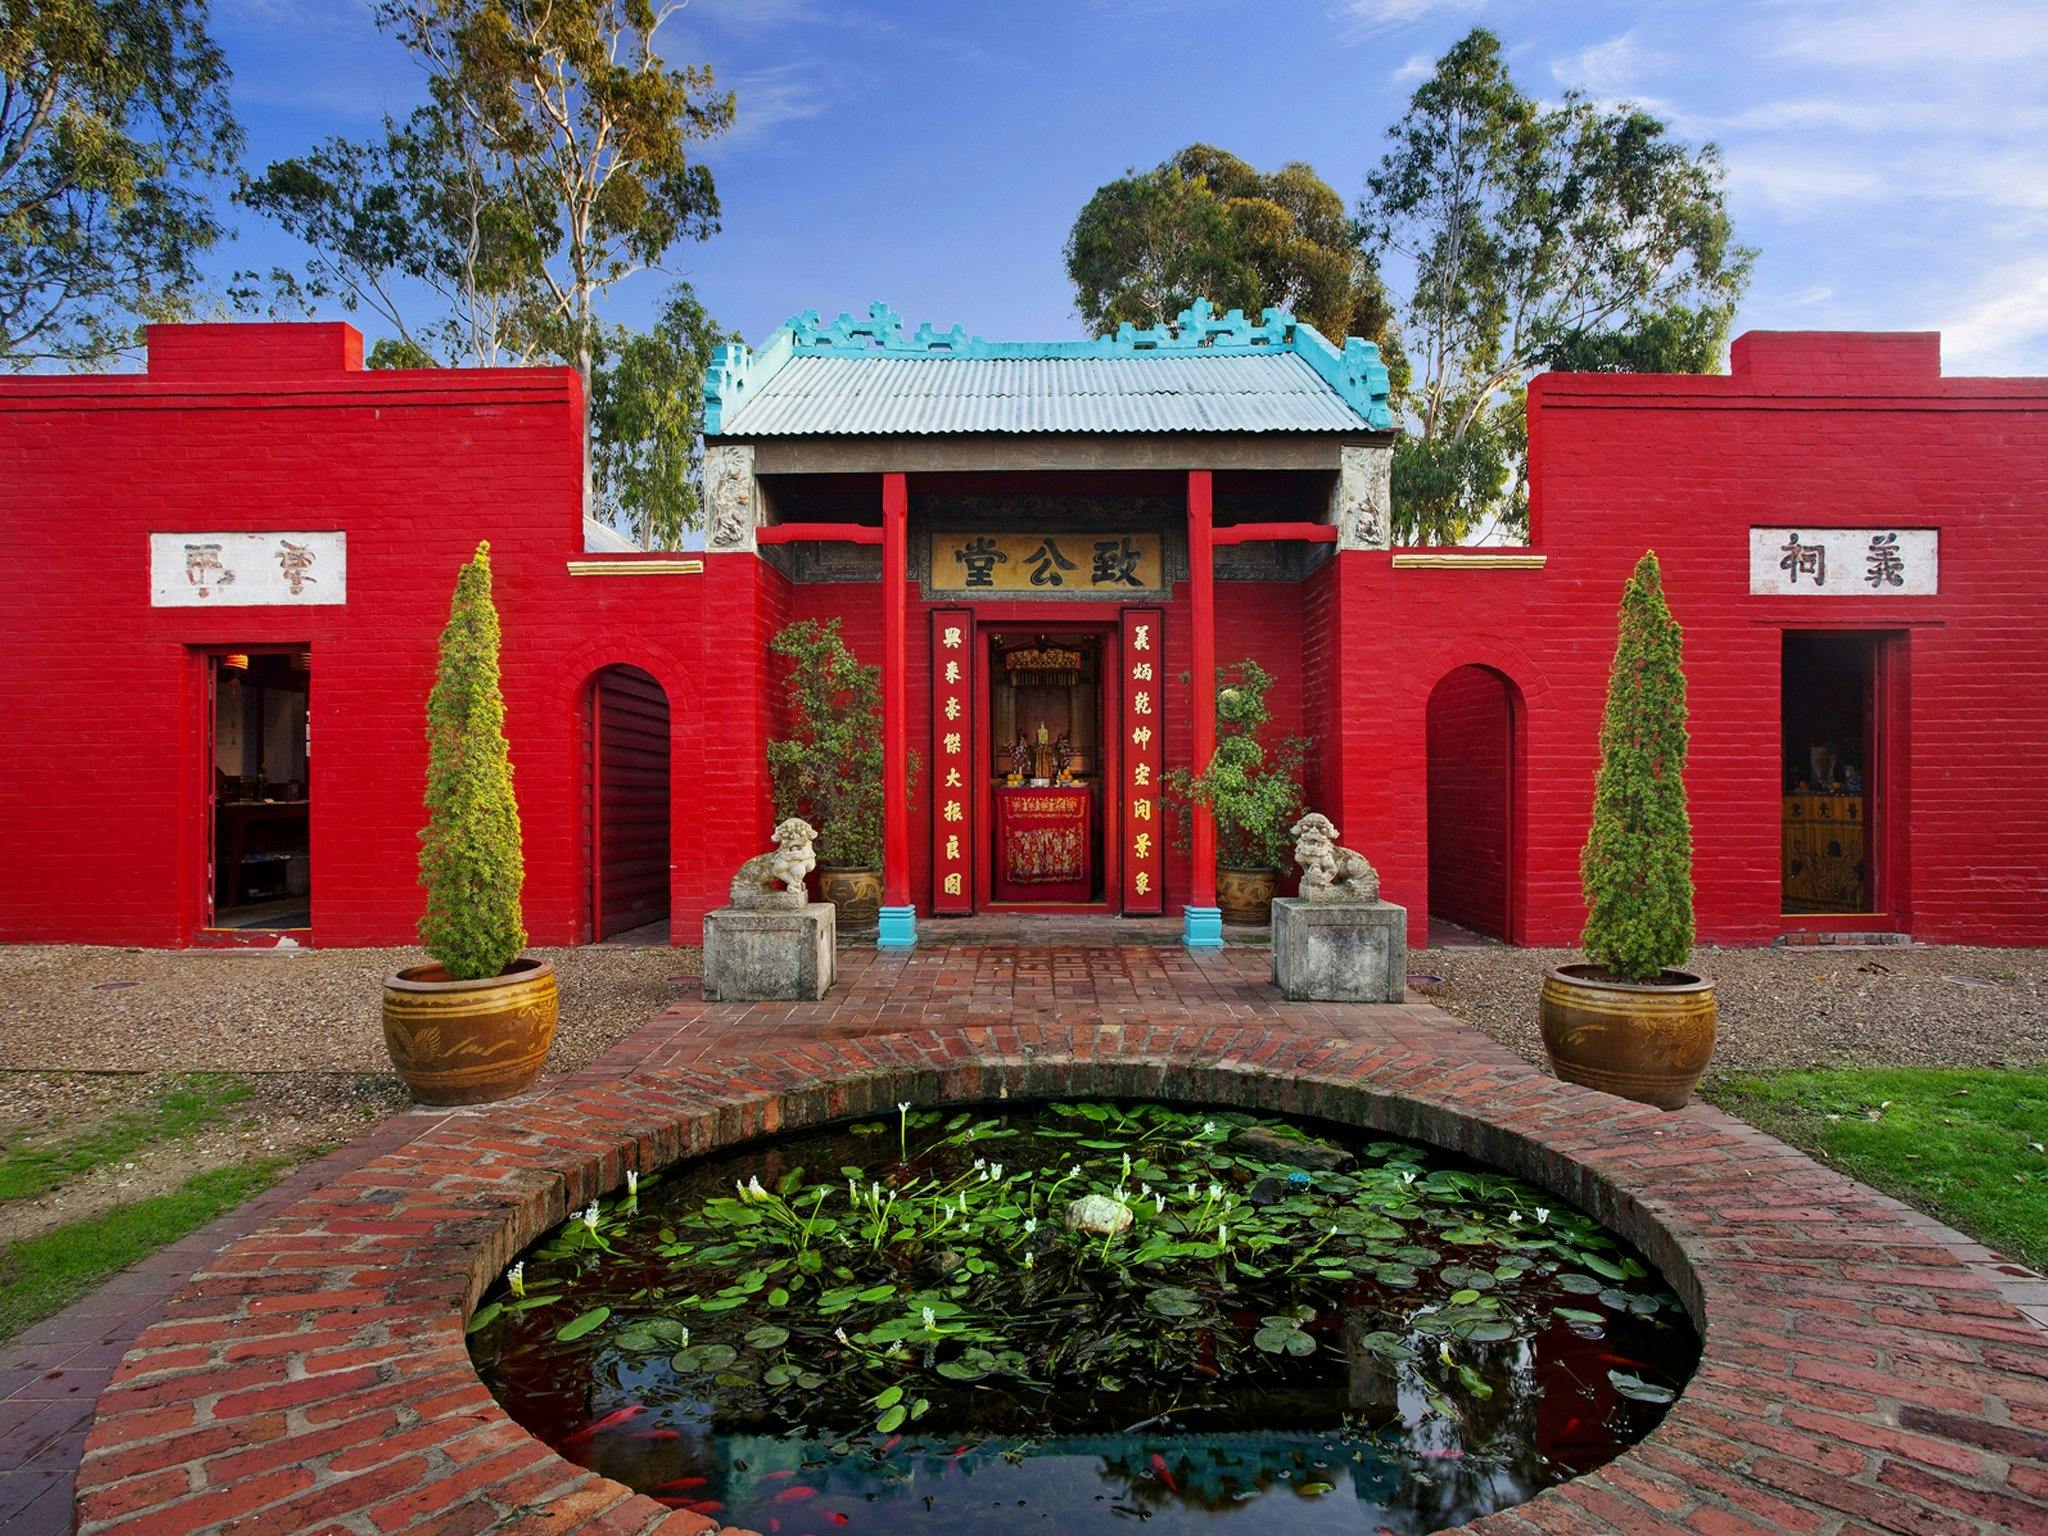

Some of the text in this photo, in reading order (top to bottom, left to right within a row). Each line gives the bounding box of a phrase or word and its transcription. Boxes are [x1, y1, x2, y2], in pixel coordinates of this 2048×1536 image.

[954, 536, 1145, 587] 致公堂
[1780, 532, 1905, 588] 義祠
